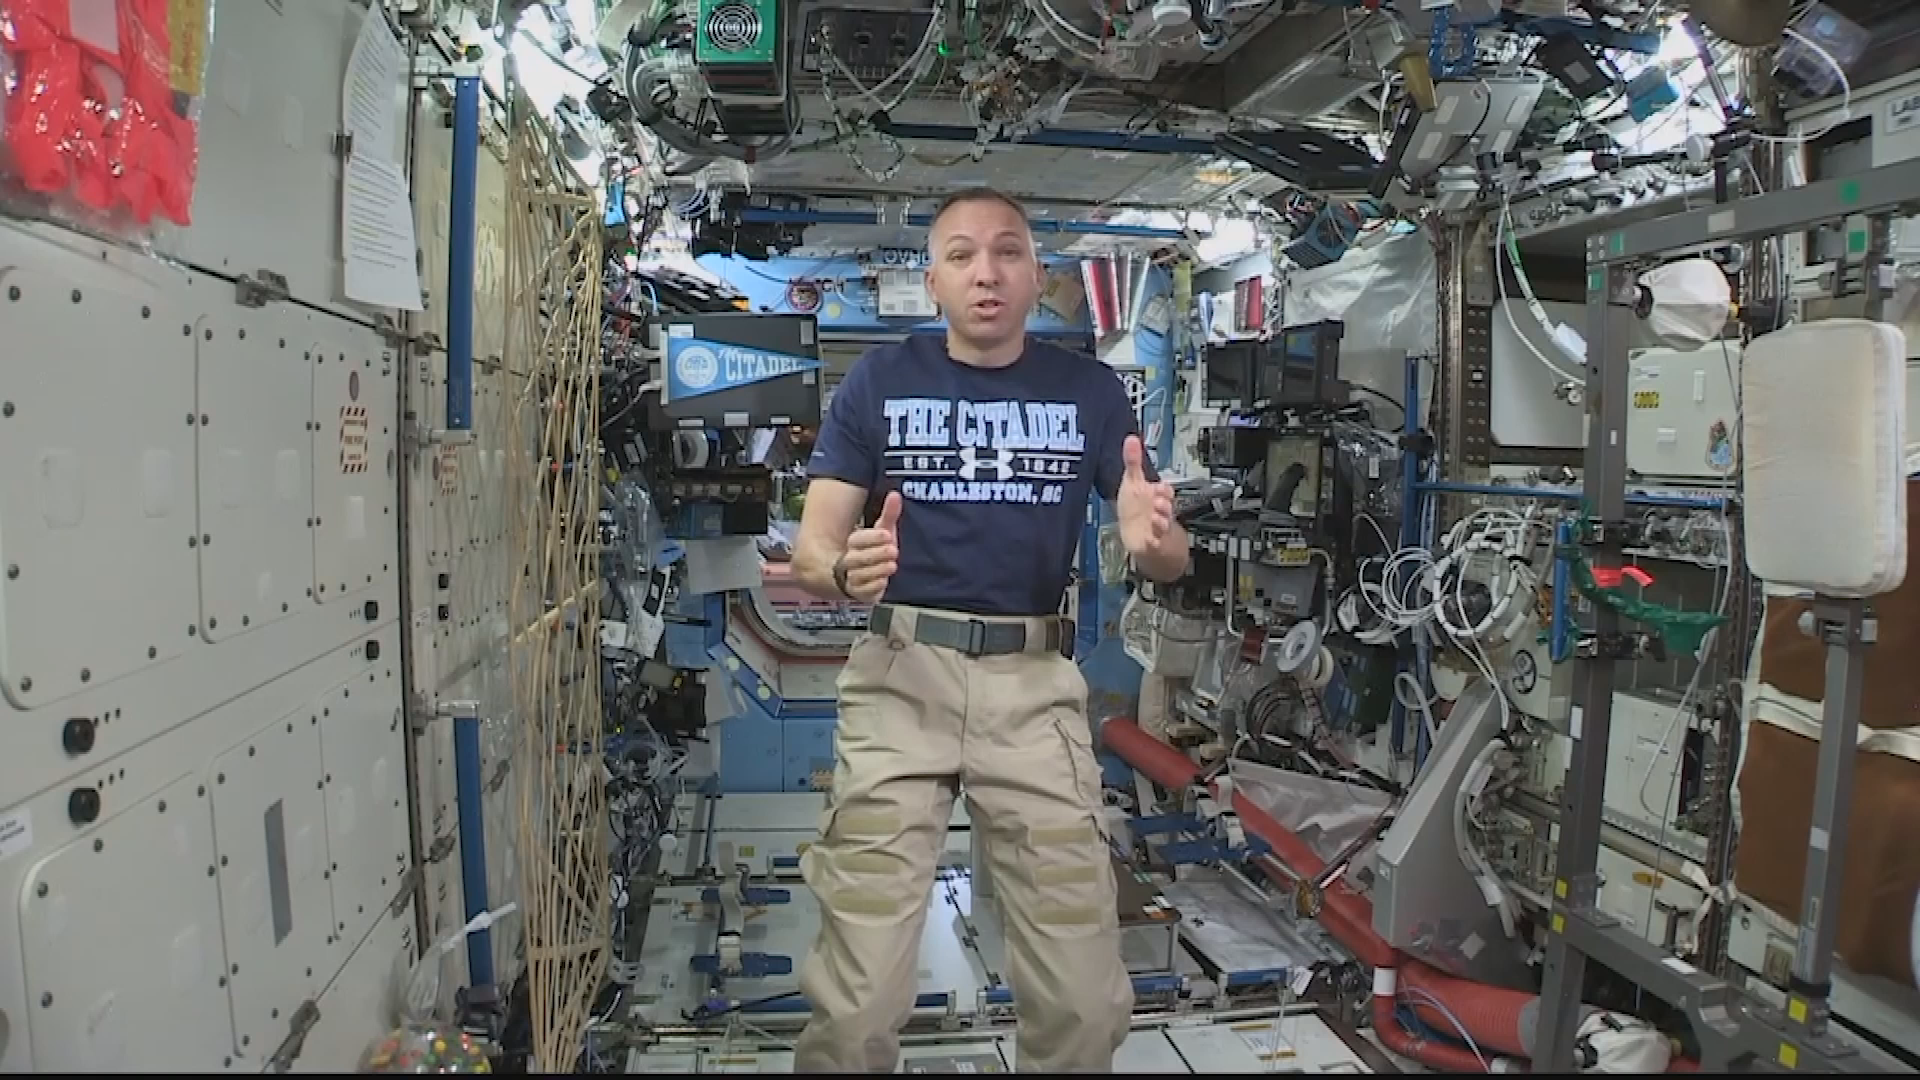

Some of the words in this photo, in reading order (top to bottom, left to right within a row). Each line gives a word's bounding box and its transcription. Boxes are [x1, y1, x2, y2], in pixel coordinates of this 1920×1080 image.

[725, 353, 801, 383] CITADEL
[884, 399, 951, 447] THE
[957, 400, 1086, 451] CITADEL
[902, 481, 1038, 505] CHARLESTON,
